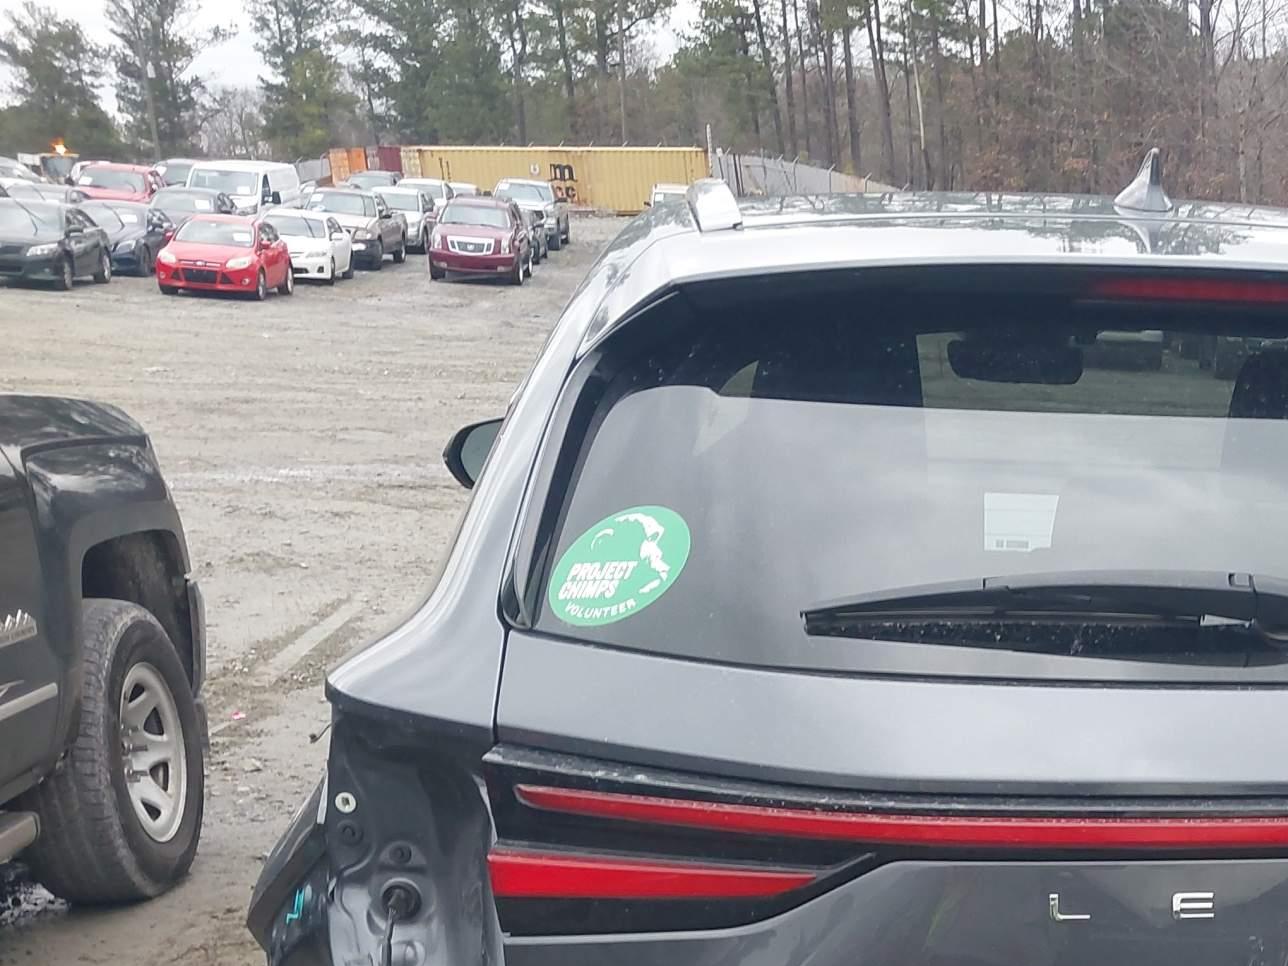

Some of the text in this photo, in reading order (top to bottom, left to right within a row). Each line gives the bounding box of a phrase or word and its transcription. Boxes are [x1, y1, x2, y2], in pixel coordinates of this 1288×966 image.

[566, 560, 638, 580] PROJECT
[558, 579, 620, 600] CHIMPS
[565, 598, 637, 619] VOLUNTEER
